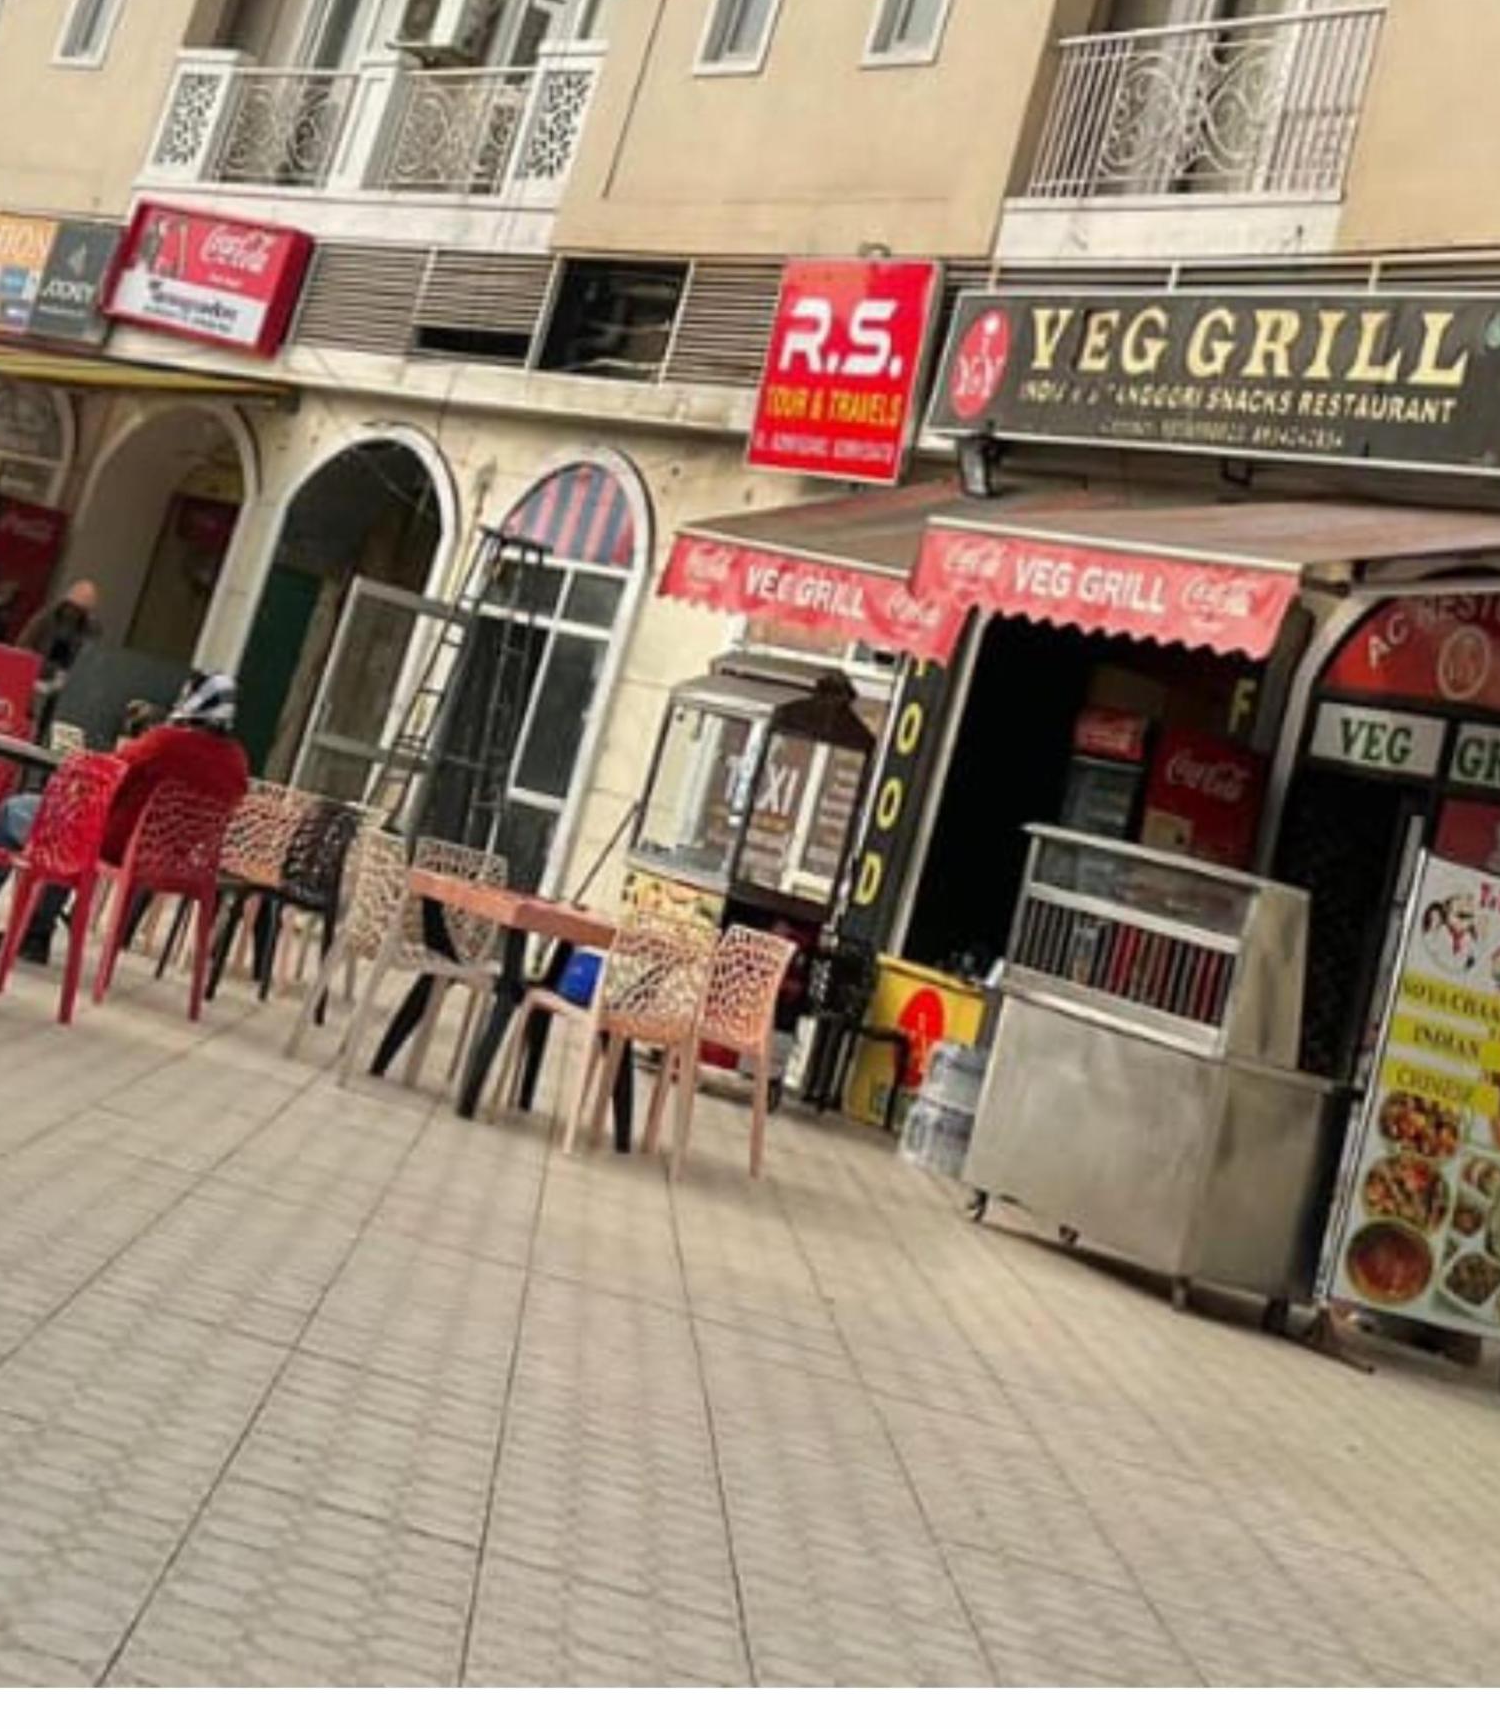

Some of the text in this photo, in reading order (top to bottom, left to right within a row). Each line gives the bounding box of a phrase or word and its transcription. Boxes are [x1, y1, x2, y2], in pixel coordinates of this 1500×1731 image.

[778, 295, 904, 380] R.S.
[1030, 305, 1470, 388] VEG GRILL
[766, 383, 810, 418] TOUR
[827, 388, 902, 428] TRAVELS
[1206, 384, 1294, 416] SNACKS
[1297, 389, 1458, 425] RESTAURANT
[794, 573, 866, 620] GRILL
[1013, 555, 1072, 600] VEG
[1077, 566, 1167, 615] GRILL
[1367, 612, 1411, 670] AC
[1339, 716, 1414, 766] VEG
[1412, 1024, 1481, 1059] INDIAN
